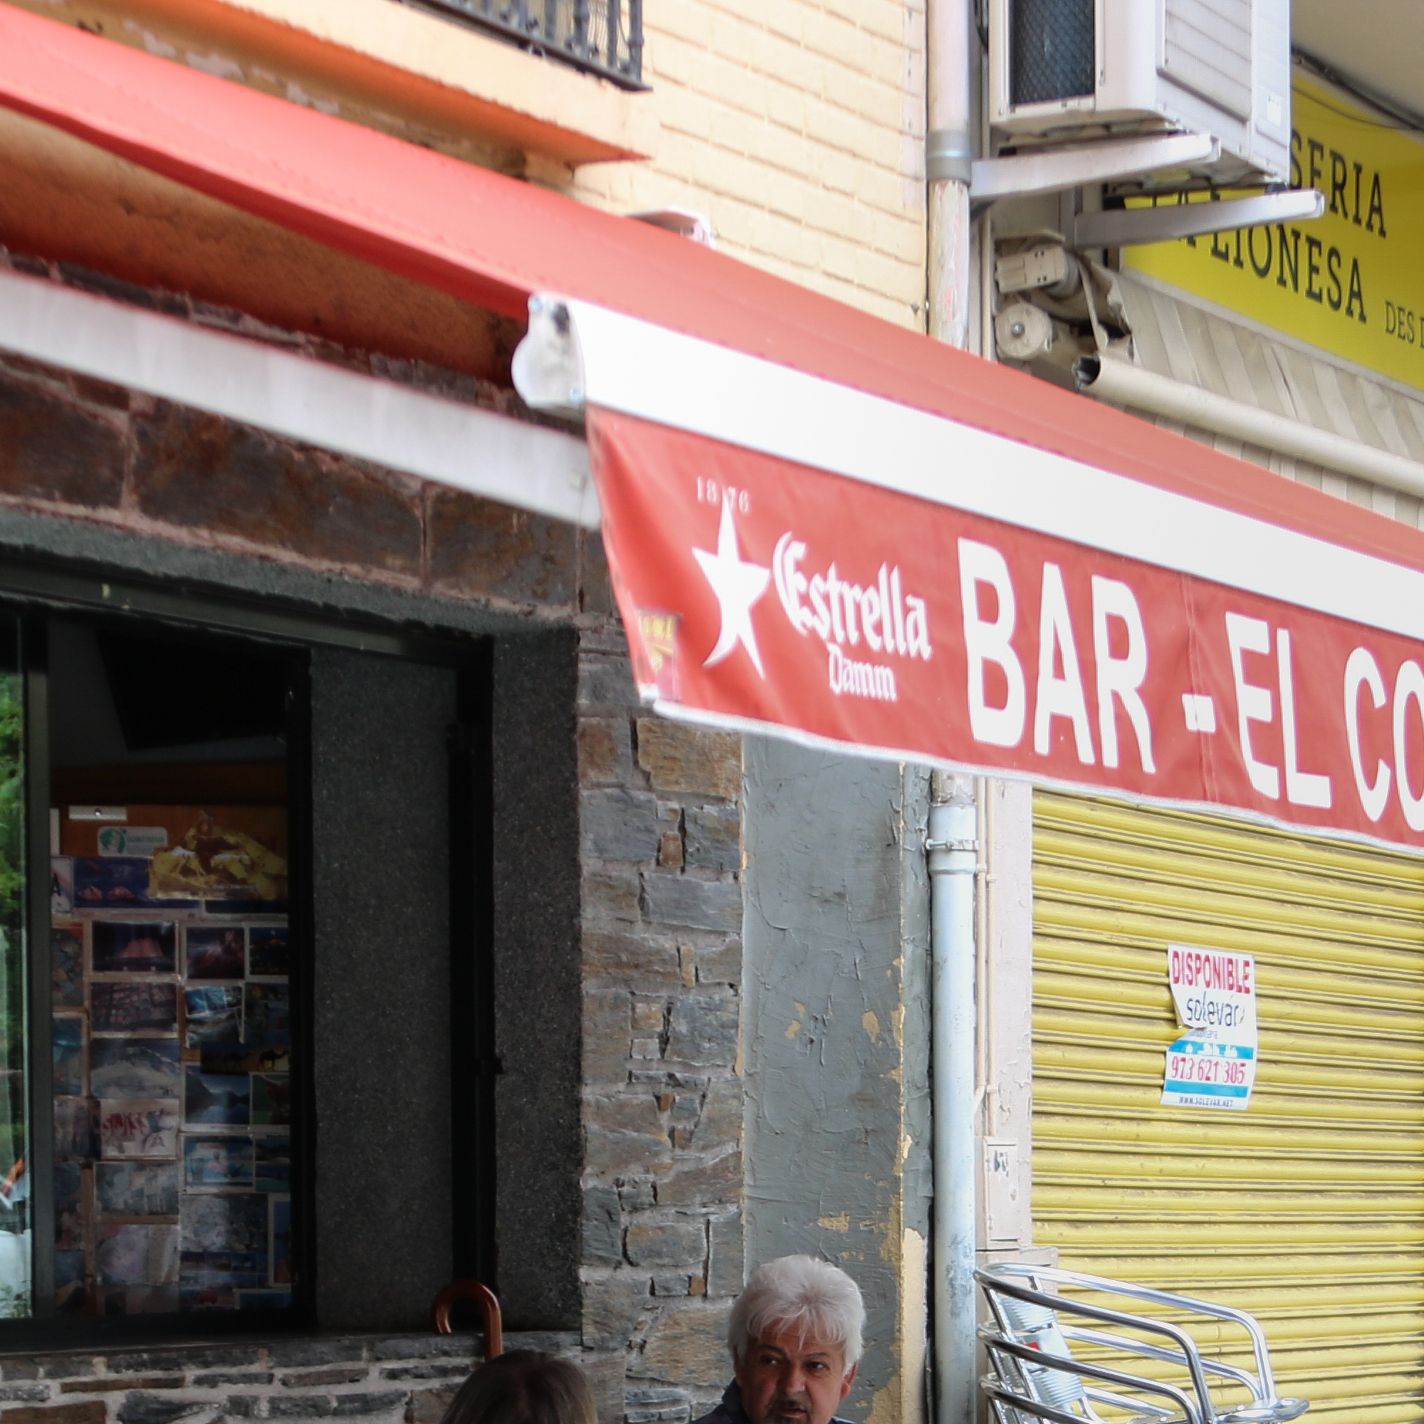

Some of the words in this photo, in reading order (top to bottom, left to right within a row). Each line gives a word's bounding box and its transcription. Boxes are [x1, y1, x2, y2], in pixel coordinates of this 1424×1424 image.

[1385, 300, 1415, 344] DES
[696, 476, 751, 514] 1876
[773, 531, 932, 661] Estrella
[827, 643, 897, 701] Damm
[957, 537, 1156, 774] BAR
[1225, 612, 1332, 809] EL
[1172, 951, 1251, 994] DISPONIBLE
[1186, 991, 1240, 1027] solevar
[1171, 1056, 1195, 1080] 973
[1197, 1059, 1220, 1082] 621
[1224, 1061, 1247, 1085] 305
